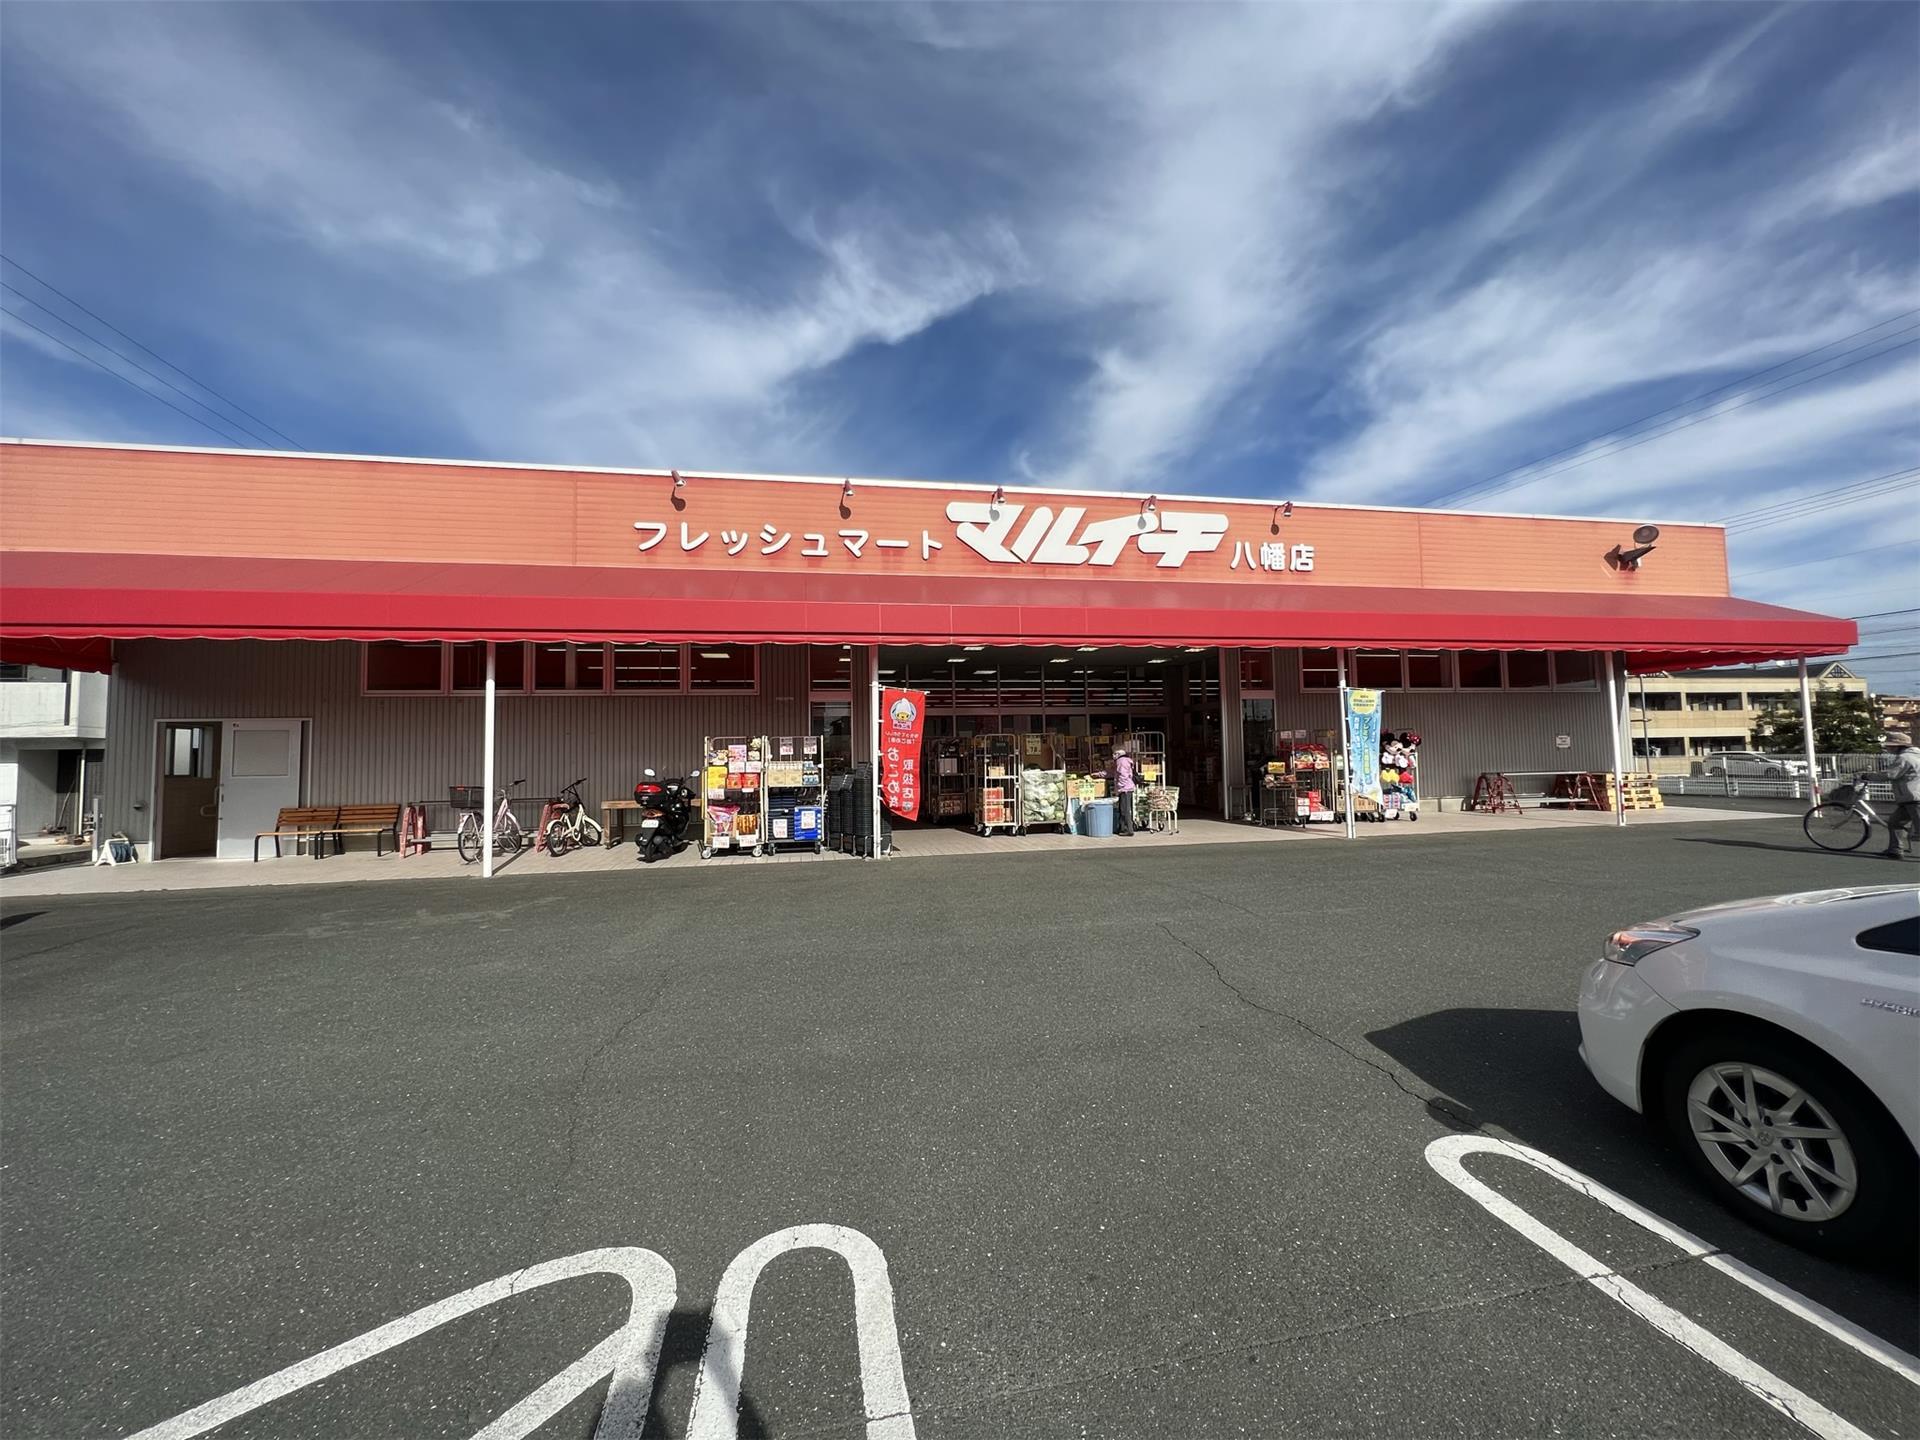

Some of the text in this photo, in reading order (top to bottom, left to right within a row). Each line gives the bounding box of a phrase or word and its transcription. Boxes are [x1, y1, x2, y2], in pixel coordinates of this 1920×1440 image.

[633, 501, 1316, 572] フレッシュマート マルイチ 八幡店
